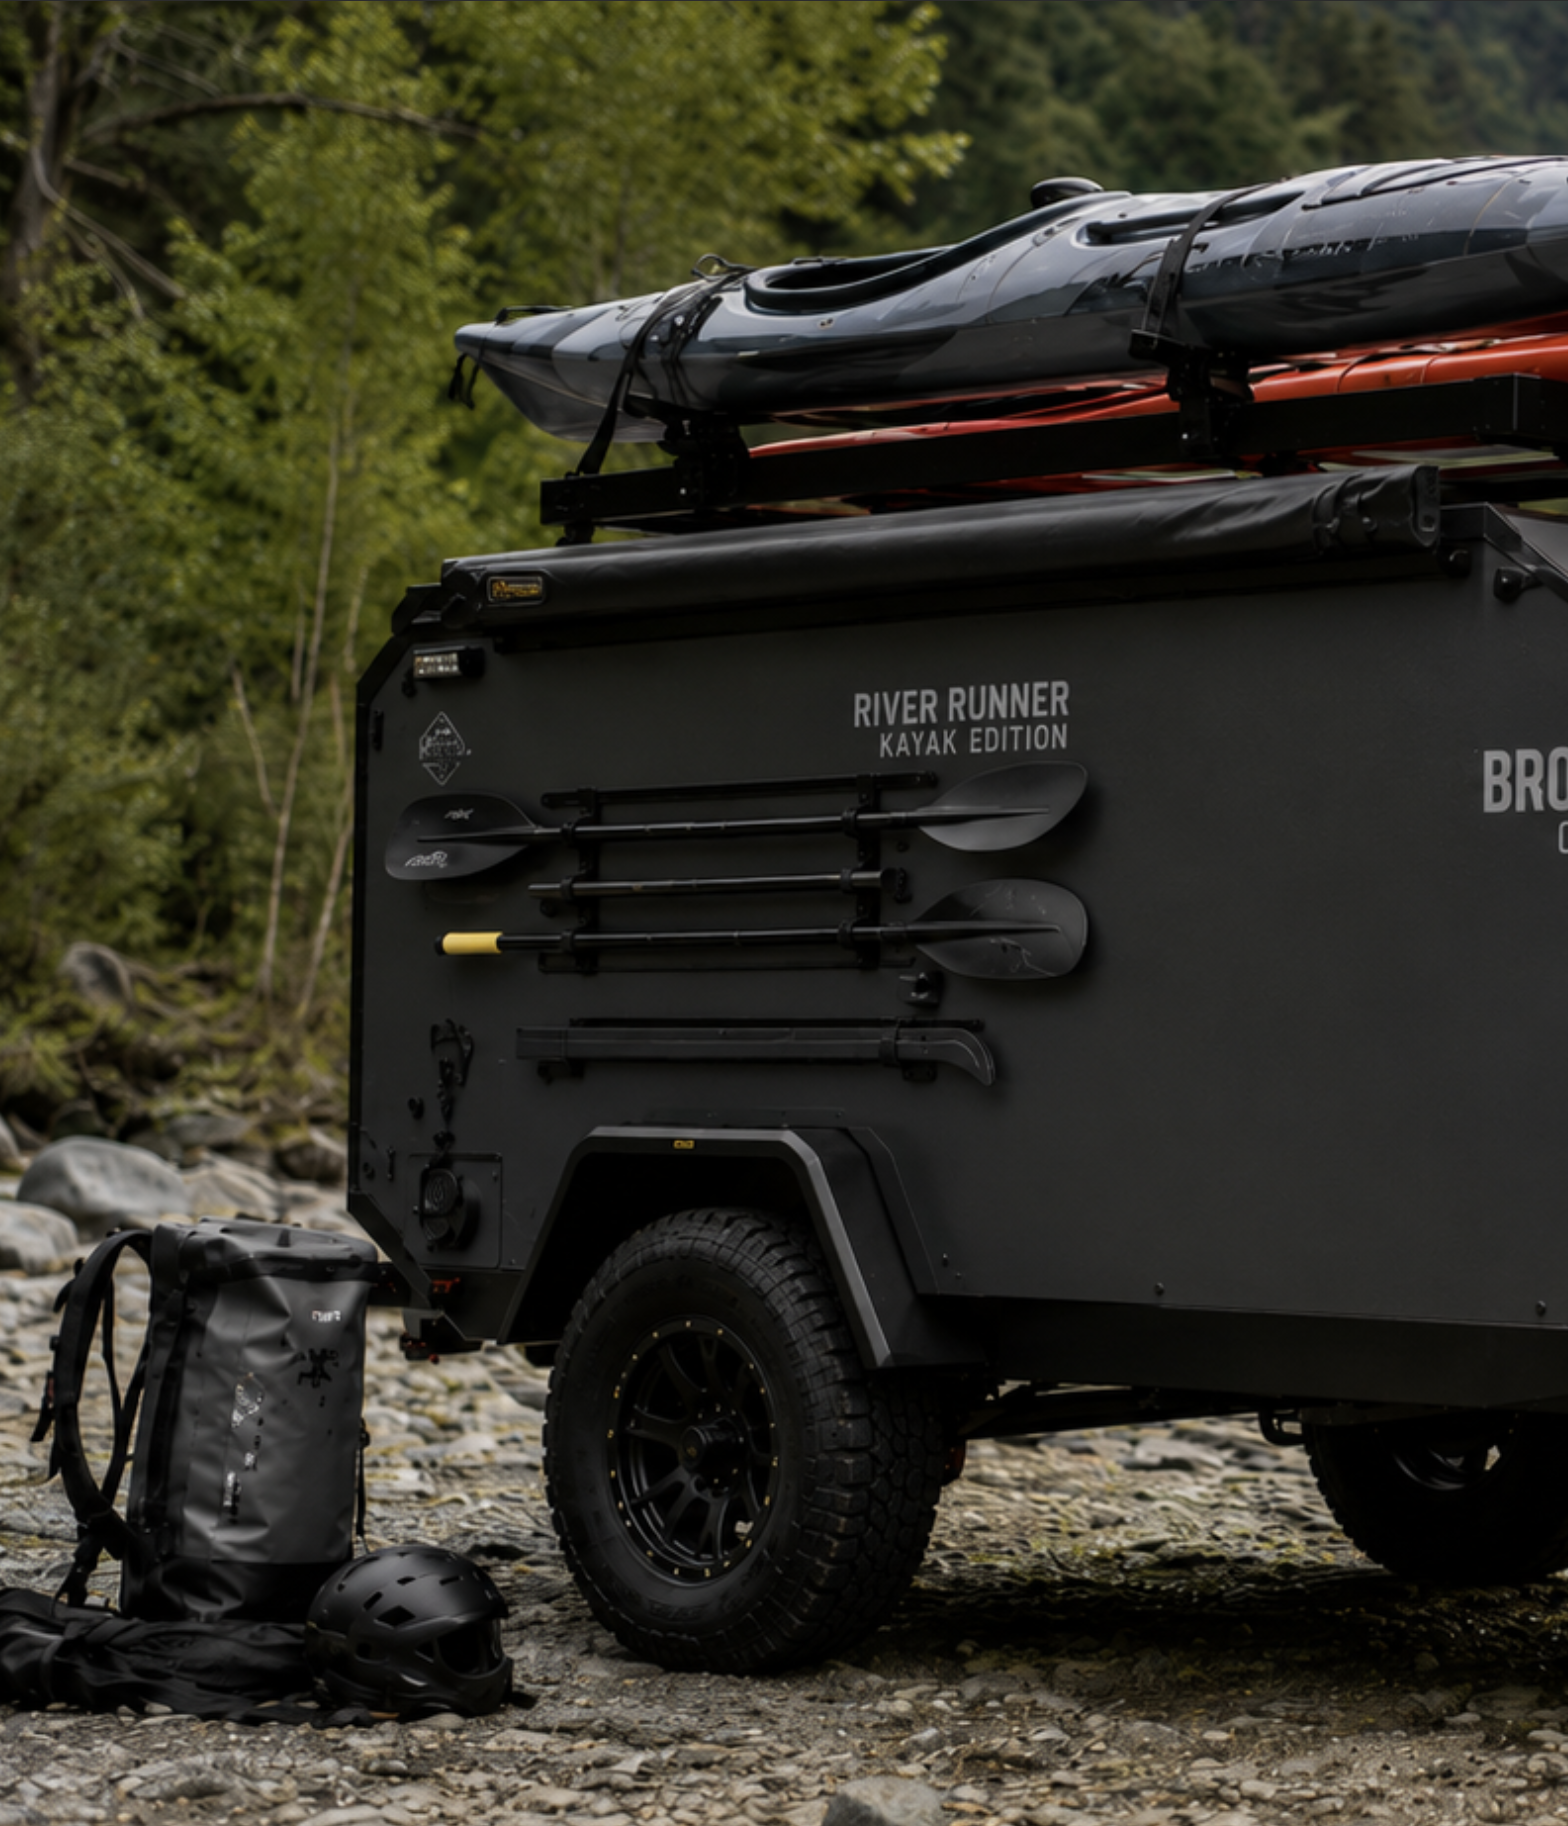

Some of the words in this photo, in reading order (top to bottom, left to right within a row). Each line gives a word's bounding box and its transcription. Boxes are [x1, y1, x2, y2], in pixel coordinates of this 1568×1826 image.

[853, 688, 938, 728] RIVER
[948, 680, 1069, 722] RUNNER
[879, 729, 957, 758] KAYAK
[969, 723, 1067, 754] EDITION
